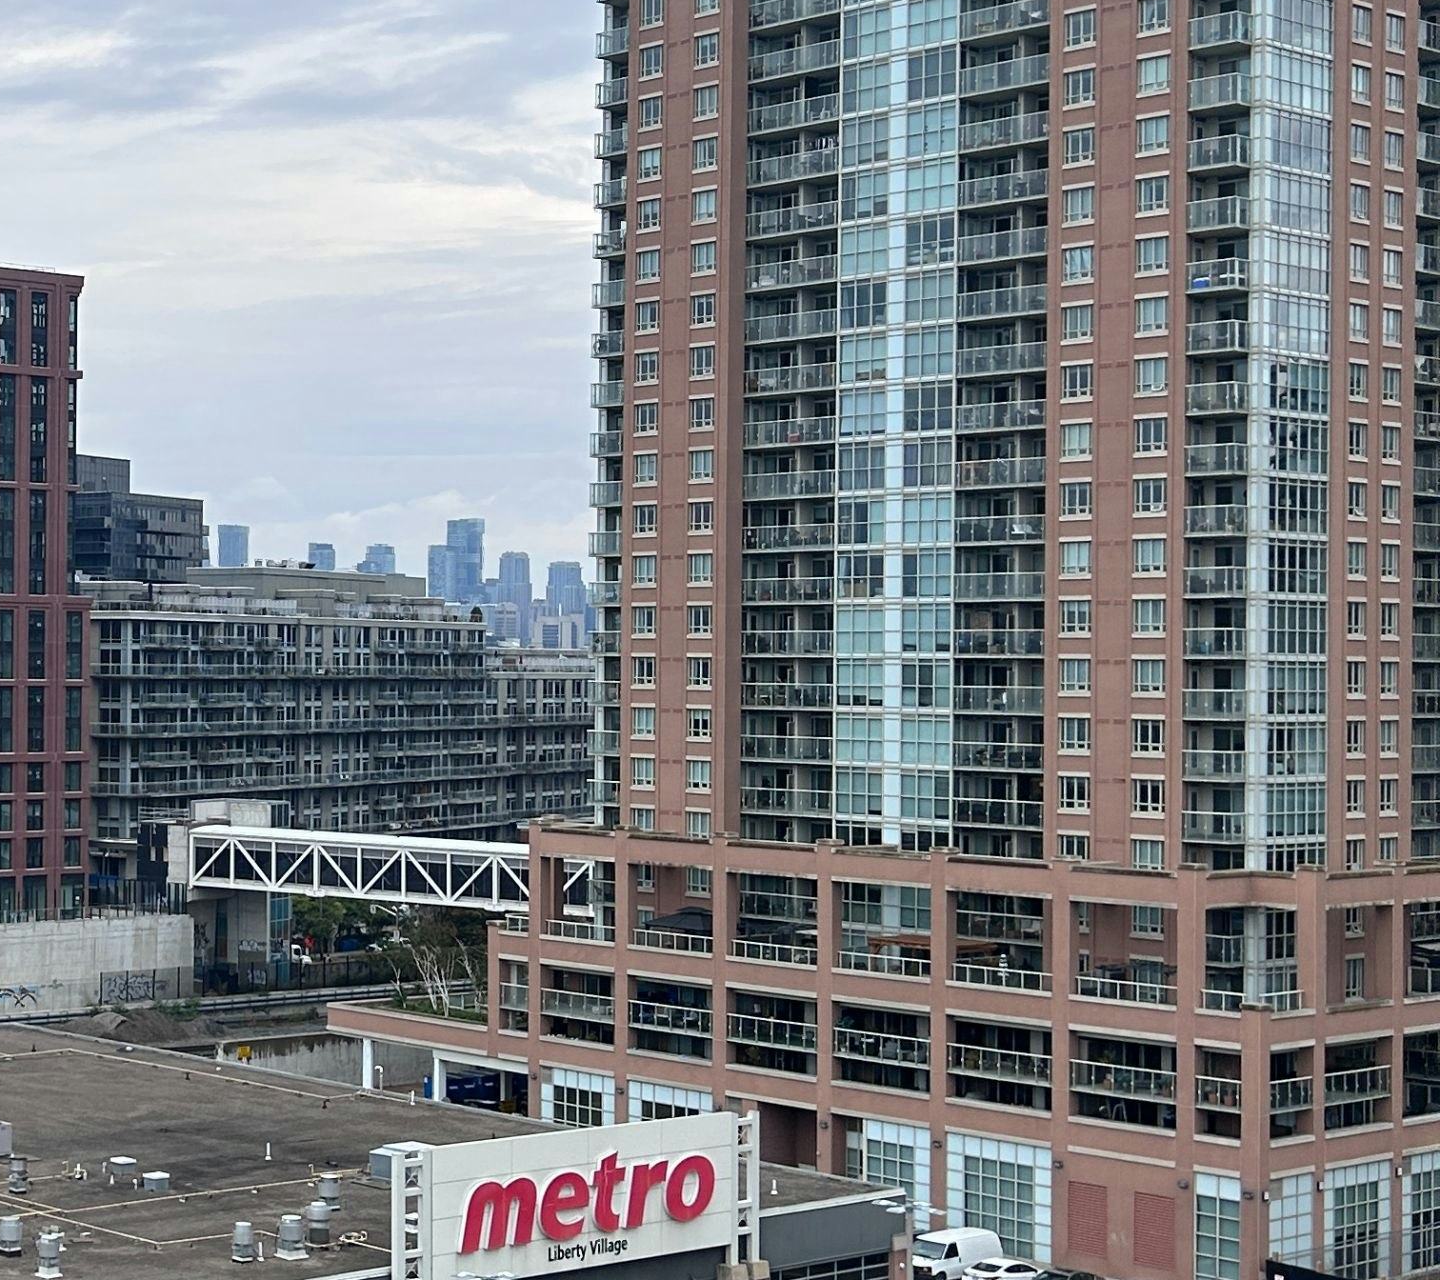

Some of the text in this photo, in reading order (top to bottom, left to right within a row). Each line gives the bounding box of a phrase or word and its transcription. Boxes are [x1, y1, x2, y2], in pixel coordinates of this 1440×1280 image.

[460, 1150, 716, 1254] metro
[548, 1238, 628, 1261] Liberty Village
